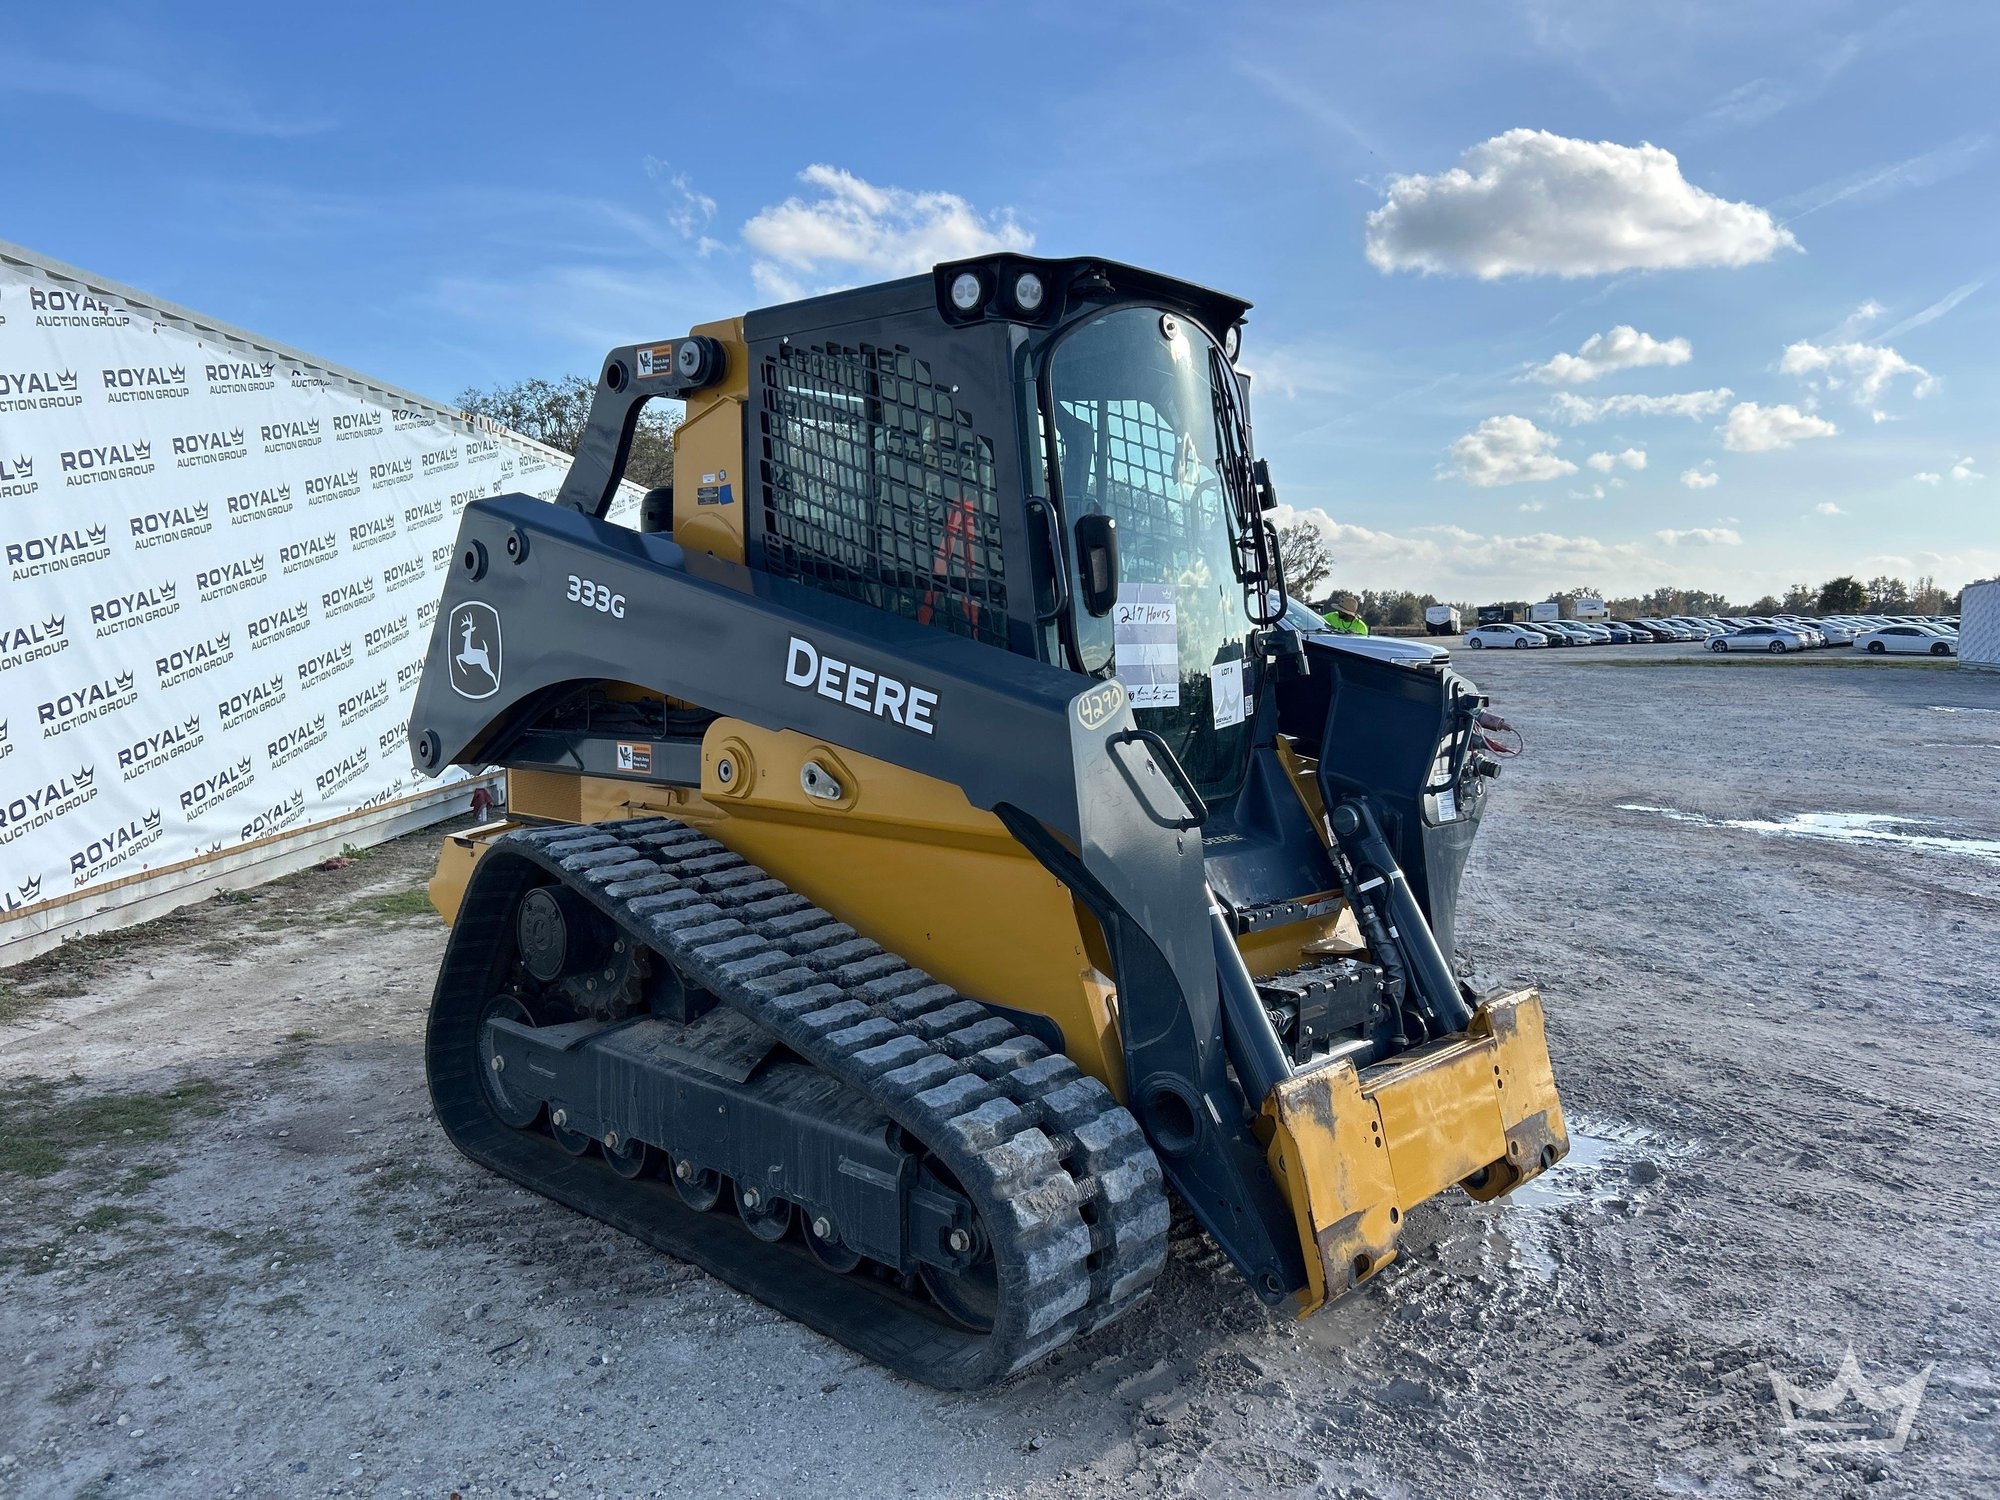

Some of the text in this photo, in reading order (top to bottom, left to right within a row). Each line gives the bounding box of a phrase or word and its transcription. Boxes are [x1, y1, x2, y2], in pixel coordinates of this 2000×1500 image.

[36, 316, 129, 327] AUCTION GROUP
[0, 373, 58, 395] OYAL
[102, 368, 170, 387] ROYAL
[205, 363, 260, 380] ROYAL
[107, 388, 189, 402] AUCTION GROUP
[210, 381, 275, 393] AUCTION GROUP
[0, 396, 82, 412] CTION GROUP
[260, 421, 308, 440] ROYAL
[333, 413, 372, 429] ROYAL
[172, 432, 230, 454] ROYAL
[264, 437, 321, 452] AUCTION GROUP
[467, 441, 493, 456] ROYAL
[60, 444, 134, 470] ROYAL
[177, 449, 247, 467] AUCTION GROUP
[369, 460, 403, 479] ROYAL
[422, 449, 450, 466] ROYAL
[66, 463, 154, 486] AUCTION GROUP
[304, 473, 348, 494] ROYAL
[0, 482, 38, 498] ROUP
[227, 488, 278, 512] ROYAL
[308, 486, 360, 505] AUCTION GROUP
[451, 488, 478, 507] ROYAL
[129, 507, 194, 535] ROYAL
[231, 503, 292, 525] AUCTION GROUP
[404, 502, 434, 522] ROYAL
[135, 523, 212, 549] AUCTION GROUP
[349, 518, 386, 540] ROYAL
[6, 531, 88, 564] ROYAL
[279, 537, 325, 562] ROYAL
[432, 543, 455, 562] ROYA
[11, 548, 111, 581] AUCTION GROUP
[196, 560, 251, 589] ROYAL
[283, 550, 338, 574] AUCTION GROUP
[383, 560, 415, 583] ROYAL
[201, 574, 266, 602] AUCTION GROUP
[322, 582, 363, 608] ROYAL
[566, 574, 626, 618] 333G
[90, 588, 160, 623] ROYAL
[325, 593, 375, 619] AUCTION GROUP
[417, 598, 440, 620] ROYA
[1120, 605, 1143, 623] 217
[96, 603, 180, 638] AUCTION GROUP
[247, 608, 296, 638] ROYAL
[364, 620, 399, 646] ROYAL
[0, 624, 44, 653] YAL
[252, 619, 310, 650] AUCTION GROUP
[25, 639, 69, 662] GROUP
[155, 640, 216, 676] ROYAL
[298, 648, 341, 679] ROYAL
[161, 652, 233, 689] AUCTION GROUP
[301, 658, 353, 690] AUCTION GROUP
[1221, 668, 1229, 676] LOT
[785, 636, 938, 735] DEERE
[37, 680, 116, 724] ROYAL
[218, 683, 271, 719] ROYAL
[223, 692, 285, 731] AUCTION GROUP
[338, 686, 377, 717] ROYAL
[1081, 688, 1120, 723] 4290
[44, 692, 137, 739] AUCTION GROUP
[118, 725, 185, 768] ROYAL
[267, 722, 314, 758] ROYAL
[272, 731, 327, 770] AUCTION GROUP
[123, 735, 203, 782] AUCTION GROUP
[316, 755, 357, 790] ROYAL
[321, 762, 369, 800] AUCTION GROUP
[179, 766, 238, 809] ROYAL
[185, 774, 254, 822] AUCTION GROUP
[355, 786, 392, 811] OYAL
[56, 788, 98, 816] GROUP
[241, 800, 292, 841] ROYAL
[280, 806, 305, 828] GROUP
[70, 822, 143, 874] ROYAL
[74, 828, 163, 888] AUCTION GROUP
